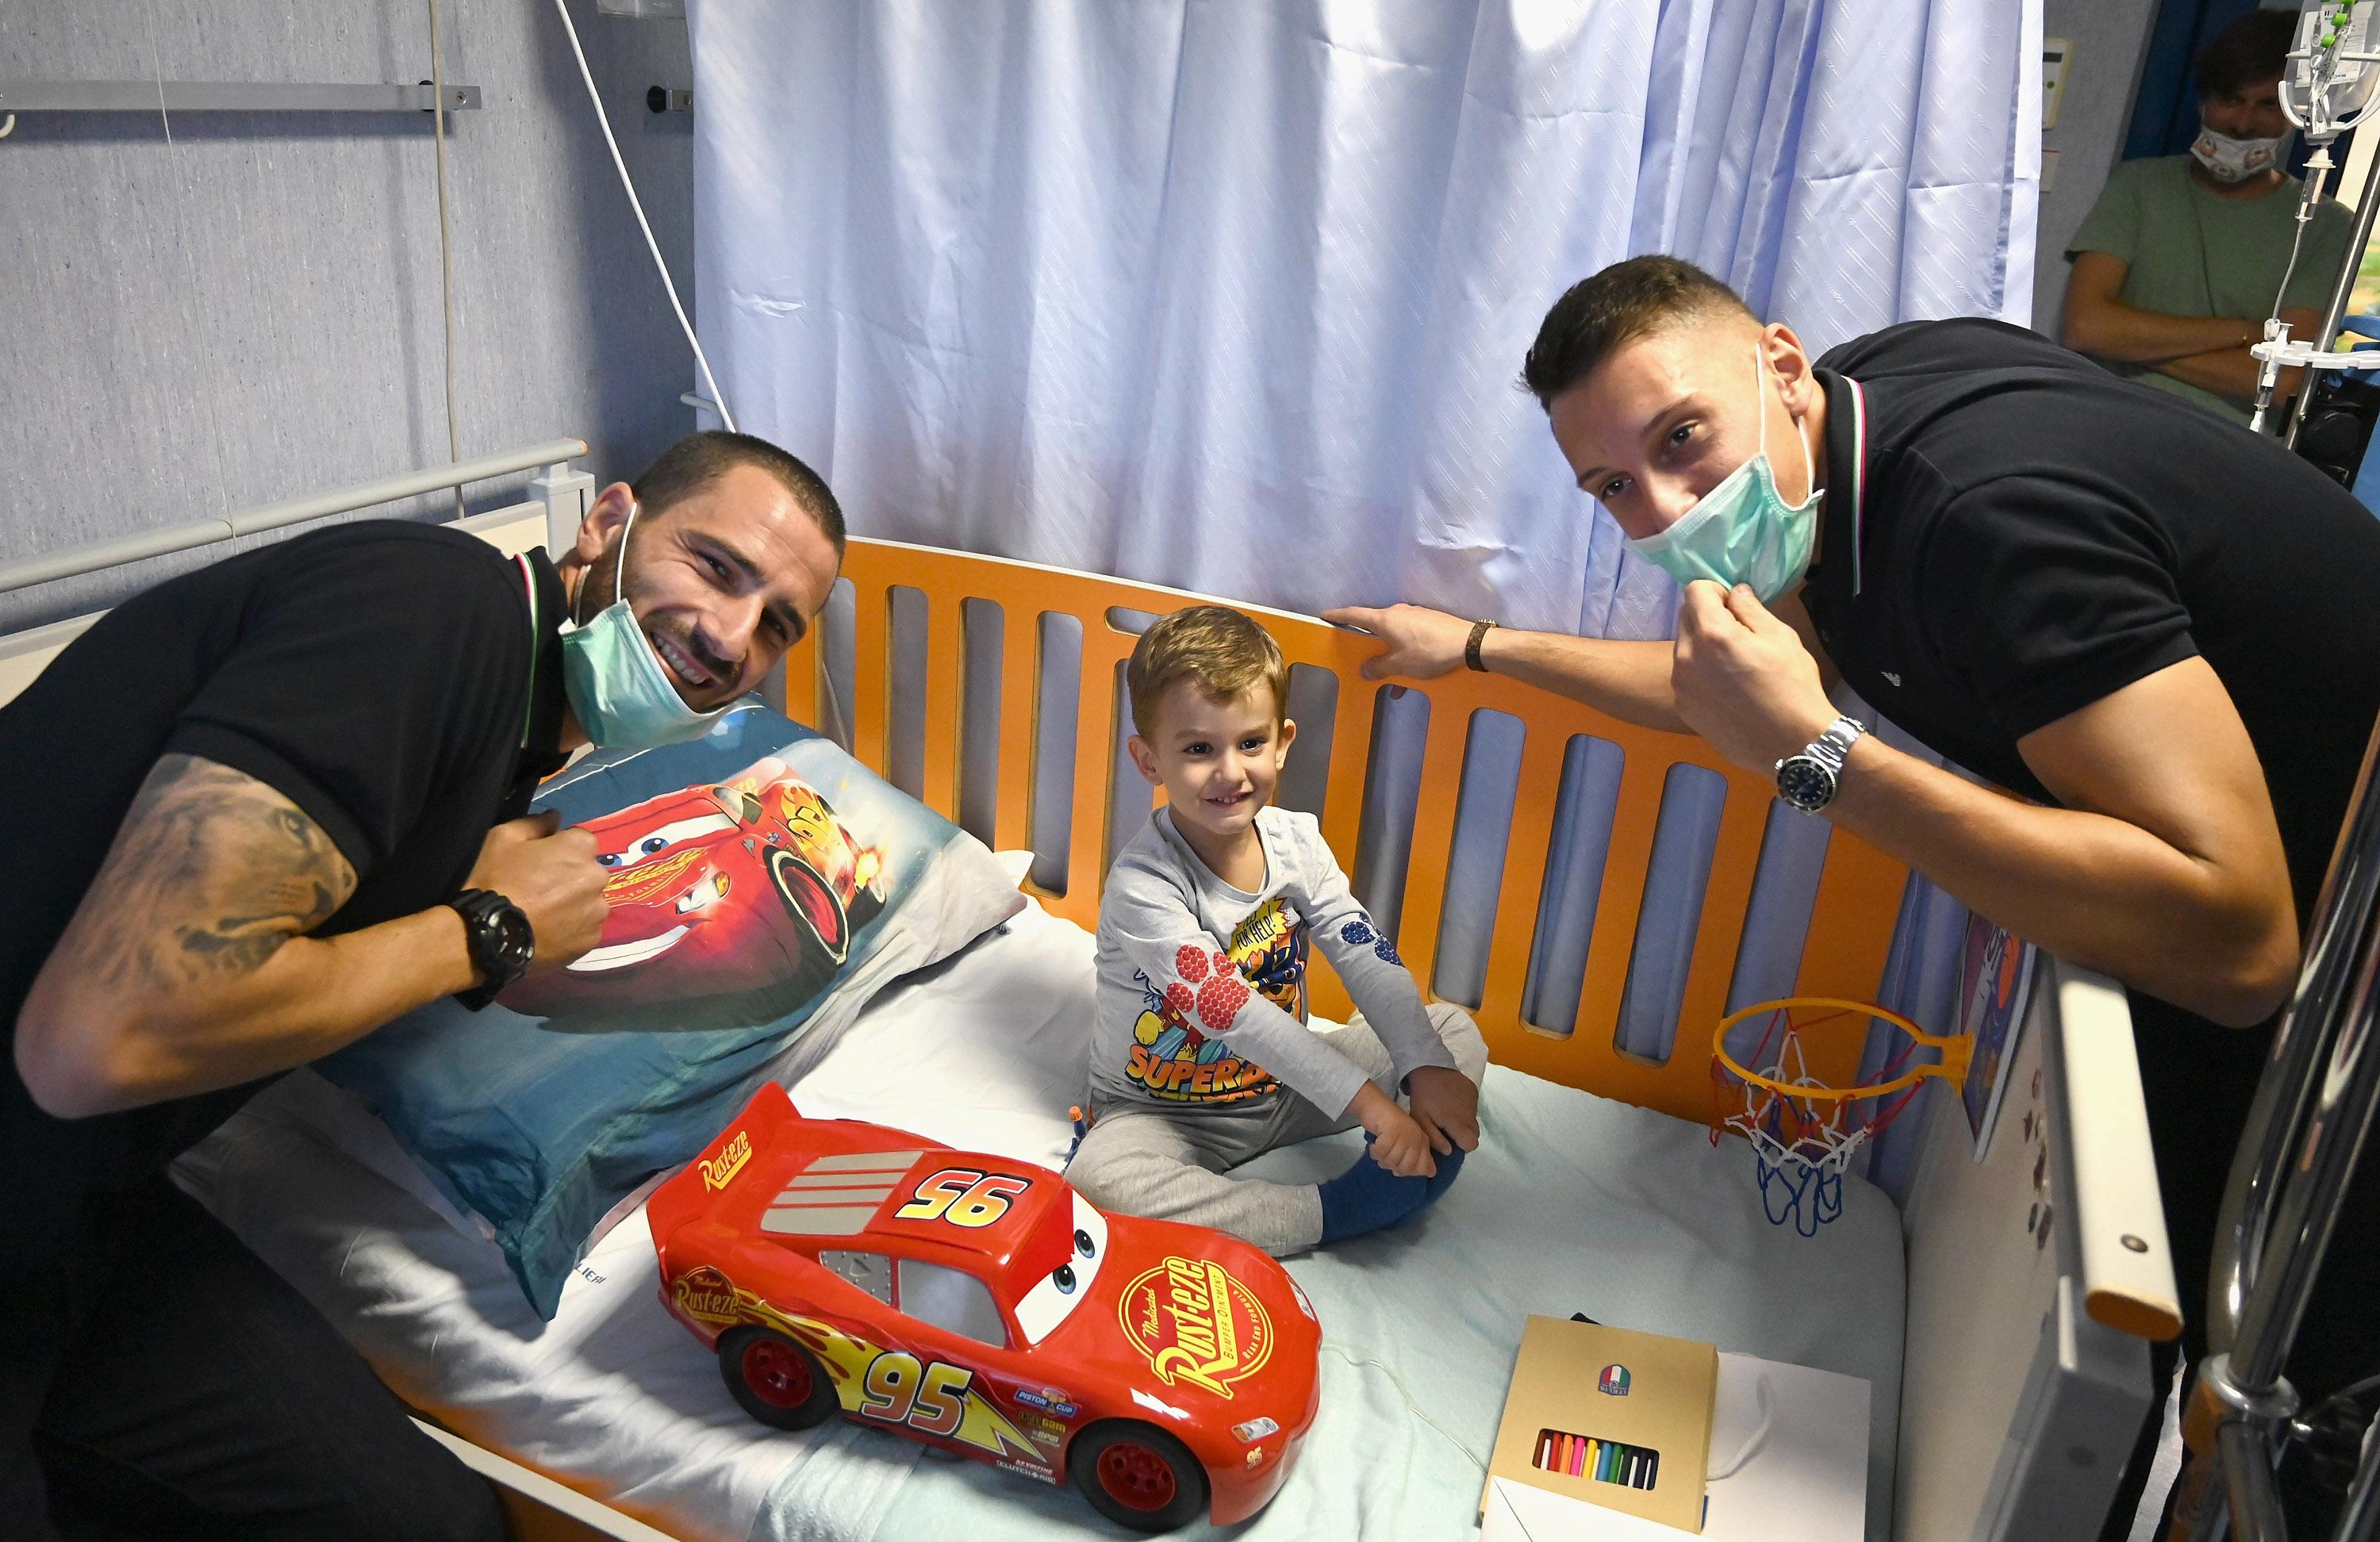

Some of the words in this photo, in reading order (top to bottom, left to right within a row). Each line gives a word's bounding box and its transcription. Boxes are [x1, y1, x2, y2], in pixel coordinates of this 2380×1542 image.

[1236, 928, 1253, 950] FOR
[1249, 904, 1276, 943] HELP!
[1125, 1043, 1242, 1095] SUPER
[1142, 1285, 1160, 1338] Medicated
[1214, 1275, 1227, 1317] OINTMENT
[1233, 1289, 1259, 1322] FORMULA
[1222, 1321, 1234, 1360] BUMPER
[1252, 1325, 1261, 1341] END
[860, 1351, 973, 1437] 95
[1019, 1391, 1047, 1406] PISTON
[1056, 1404, 1073, 1413] CUP
[1246, 1446, 1262, 1470] 95
